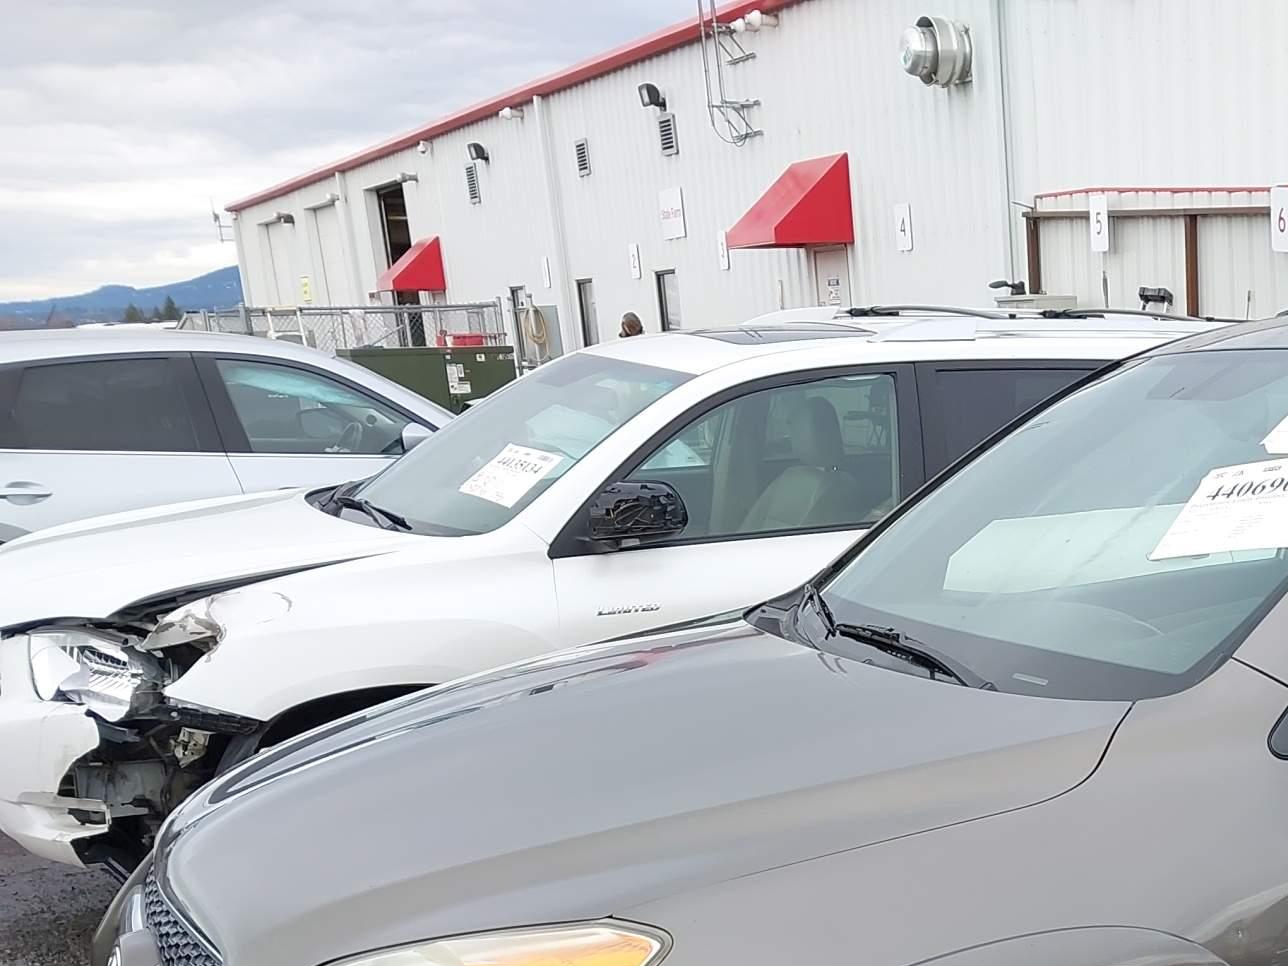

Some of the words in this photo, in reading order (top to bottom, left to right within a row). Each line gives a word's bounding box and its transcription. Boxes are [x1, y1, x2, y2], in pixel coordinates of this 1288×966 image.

[899, 217, 906, 237] 4
[1095, 212, 1102, 235] 5
[1277, 207, 1287, 233] 6
